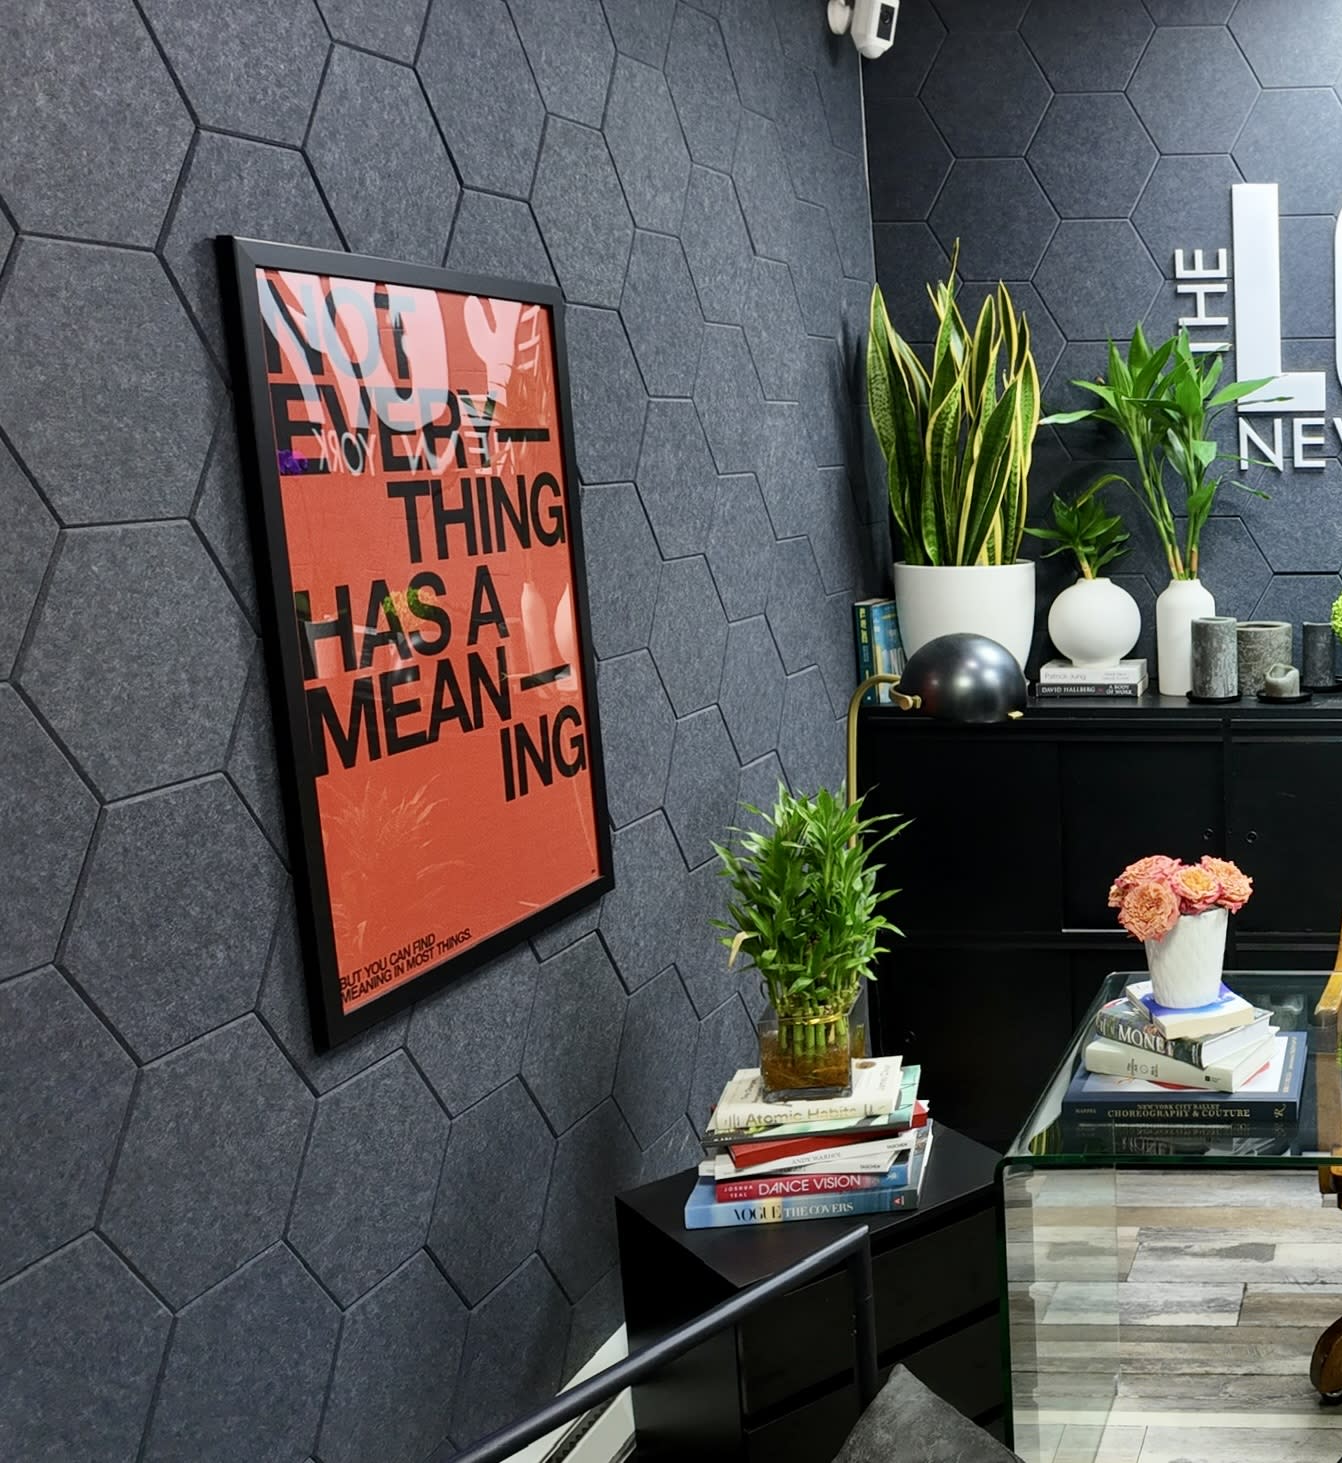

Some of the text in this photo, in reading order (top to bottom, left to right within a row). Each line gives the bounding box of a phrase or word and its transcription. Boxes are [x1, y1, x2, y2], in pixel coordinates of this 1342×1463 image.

[264, 278, 417, 381] NOT
[386, 472, 566, 564] THING
[294, 564, 511, 681] HAS A
[500, 704, 587, 803] ING
[339, 932, 436, 991] BUT YOU CAN FIND
[340, 928, 473, 1004] MEANING IN MOST THINGS.
[746, 1110, 803, 1126] Atomic
[1107, 1108, 1250, 1118] CHOREOGRAPHY & COUTURE
[724, 1184, 753, 1193] JOSHUA
[733, 1202, 854, 1221] VOGUE THE COVERS
[758, 1175, 861, 1196] DANCE VISION
